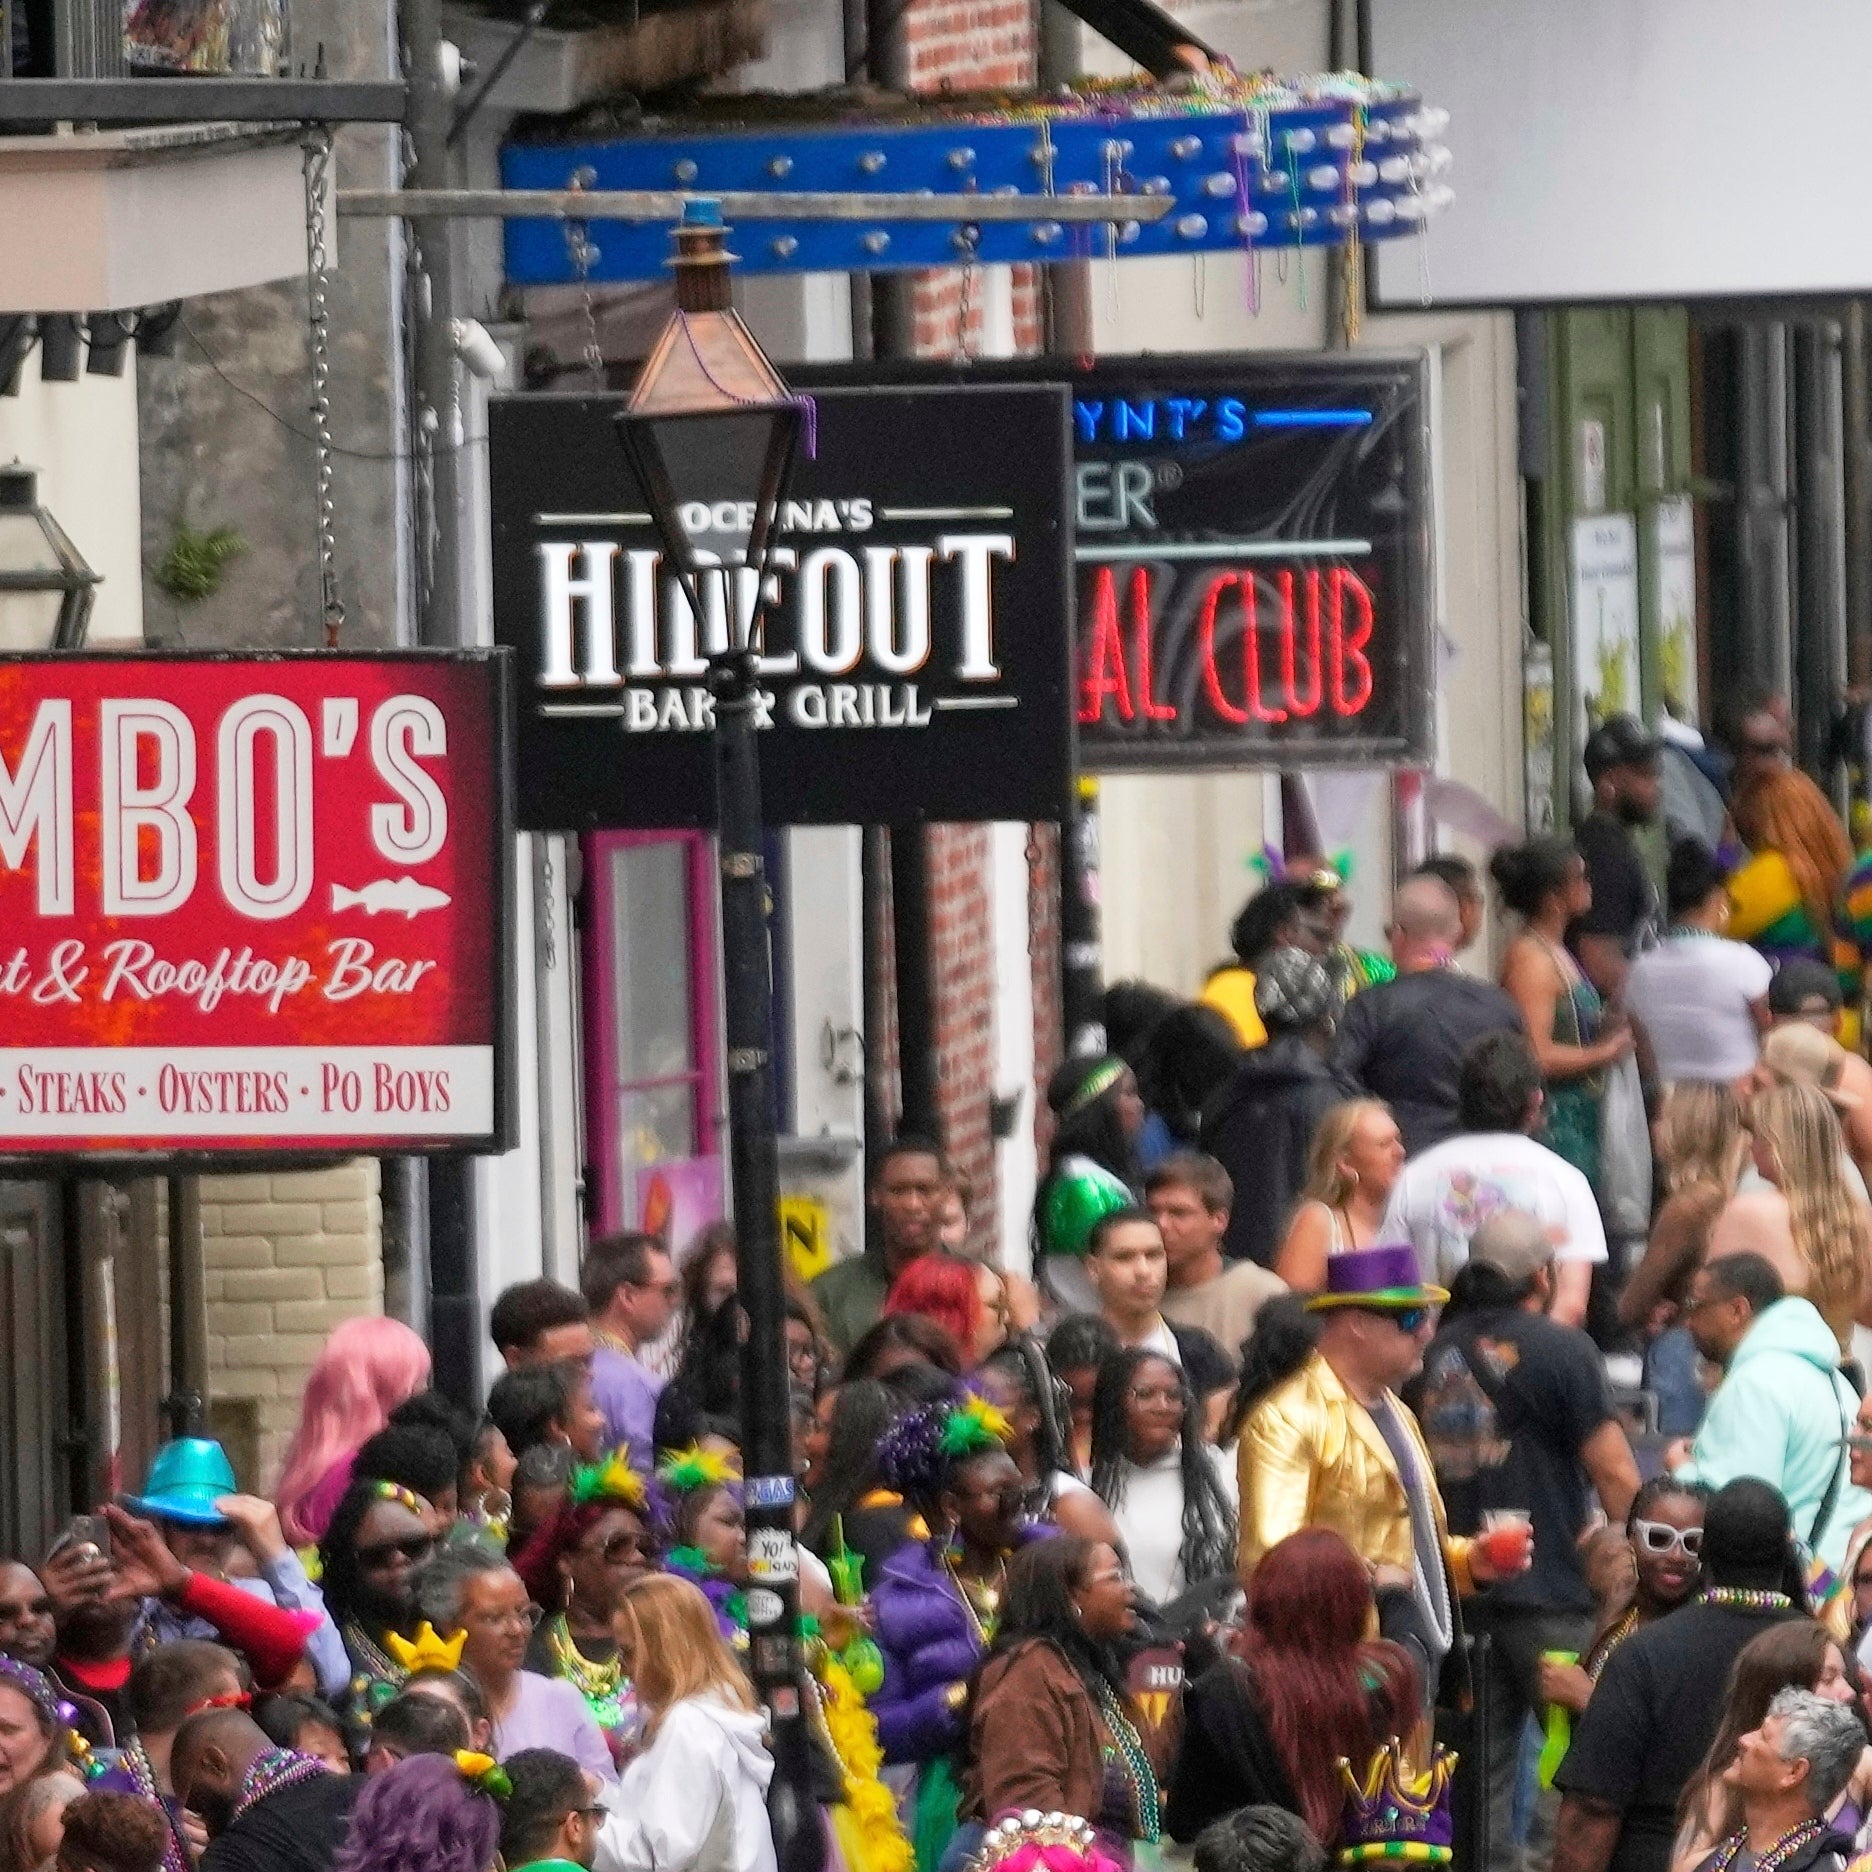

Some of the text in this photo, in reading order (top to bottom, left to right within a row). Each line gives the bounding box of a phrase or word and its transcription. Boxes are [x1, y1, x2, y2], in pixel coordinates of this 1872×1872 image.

[1074, 398, 1247, 443] YNT'S
[681, 499, 874, 533] OCENA'S
[538, 534, 1017, 687] HIDEOUT
[1199, 567, 1376, 724] CLUB
[627, 686, 718, 733] BAR
[795, 684, 933, 729] GRILL
[33, 939, 90, 1002] &
[103, 938, 315, 1013] Rooftop
[324, 938, 436, 1002] Bar
[17, 1062, 127, 1115] STEAKS
[158, 1061, 290, 1115] OYSTERS
[321, 1062, 362, 1113] PO
[373, 1061, 451, 1113] BOYS
